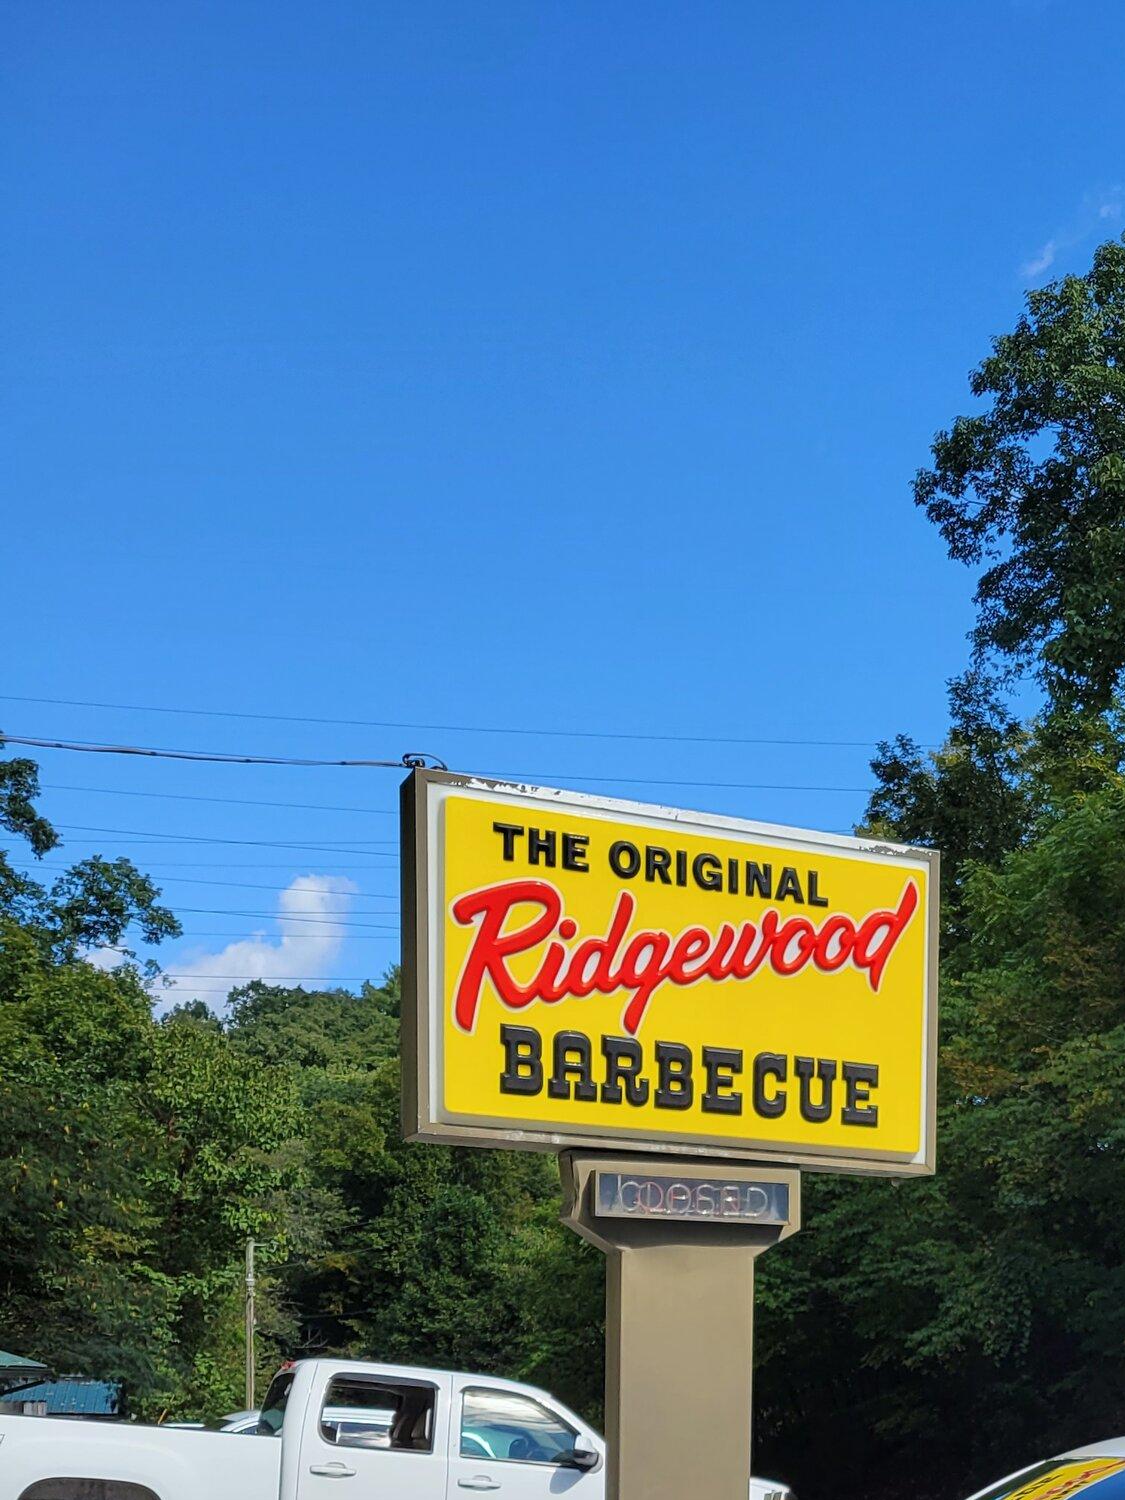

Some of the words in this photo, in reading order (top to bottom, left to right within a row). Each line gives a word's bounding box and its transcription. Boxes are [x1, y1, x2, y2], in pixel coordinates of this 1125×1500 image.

[493, 822, 590, 872] THE
[609, 840, 829, 907] ORIGINAL
[452, 879, 918, 1035] Ridgewood
[500, 1023, 879, 1128] BARBECUE
